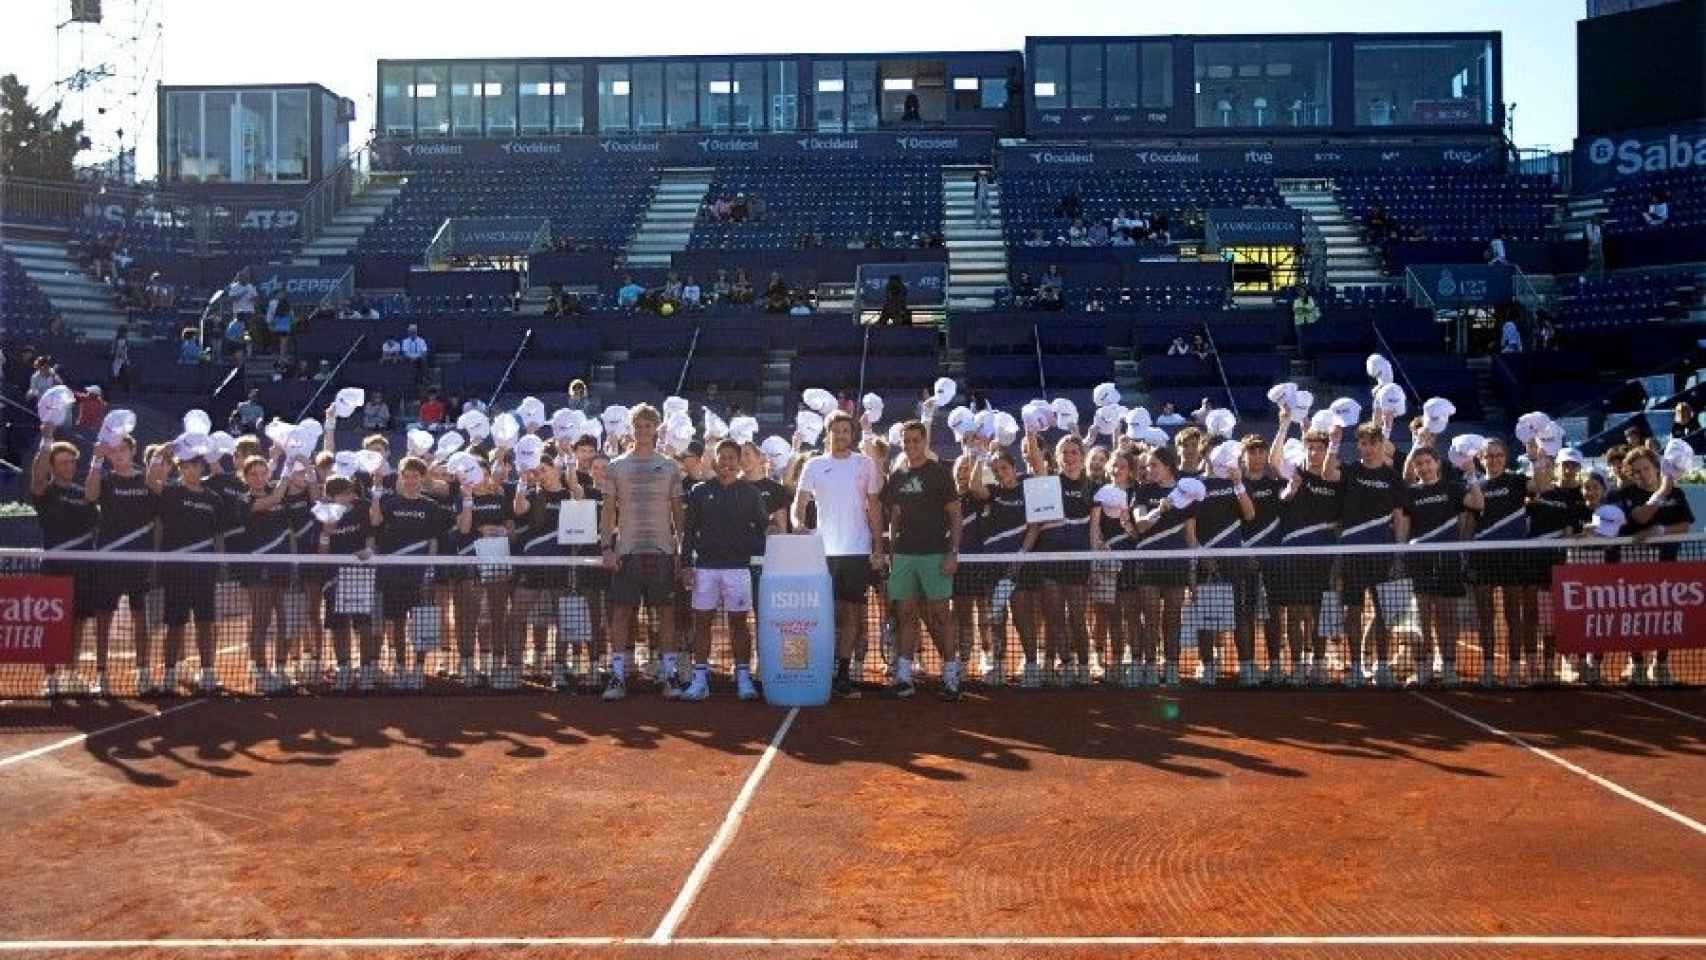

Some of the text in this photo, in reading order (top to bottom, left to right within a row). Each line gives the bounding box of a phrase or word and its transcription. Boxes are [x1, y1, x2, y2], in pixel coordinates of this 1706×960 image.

[416, 144, 463, 154] Occident
[511, 142, 561, 153] Occident
[610, 141, 659, 152] Occident
[711, 138, 760, 150] Occident
[809, 137, 858, 150] Occident
[1043, 152, 1094, 163] Occident
[1149, 152, 1200, 163] Occident
[1245, 151, 1273, 164] rtve
[1442, 150, 1472, 164] rtve
[771, 591, 820, 608] ISDIN
[1561, 578, 1705, 610] Emirates
[0, 594, 64, 622] ates
[1586, 610, 1684, 637] FLY BETTER
